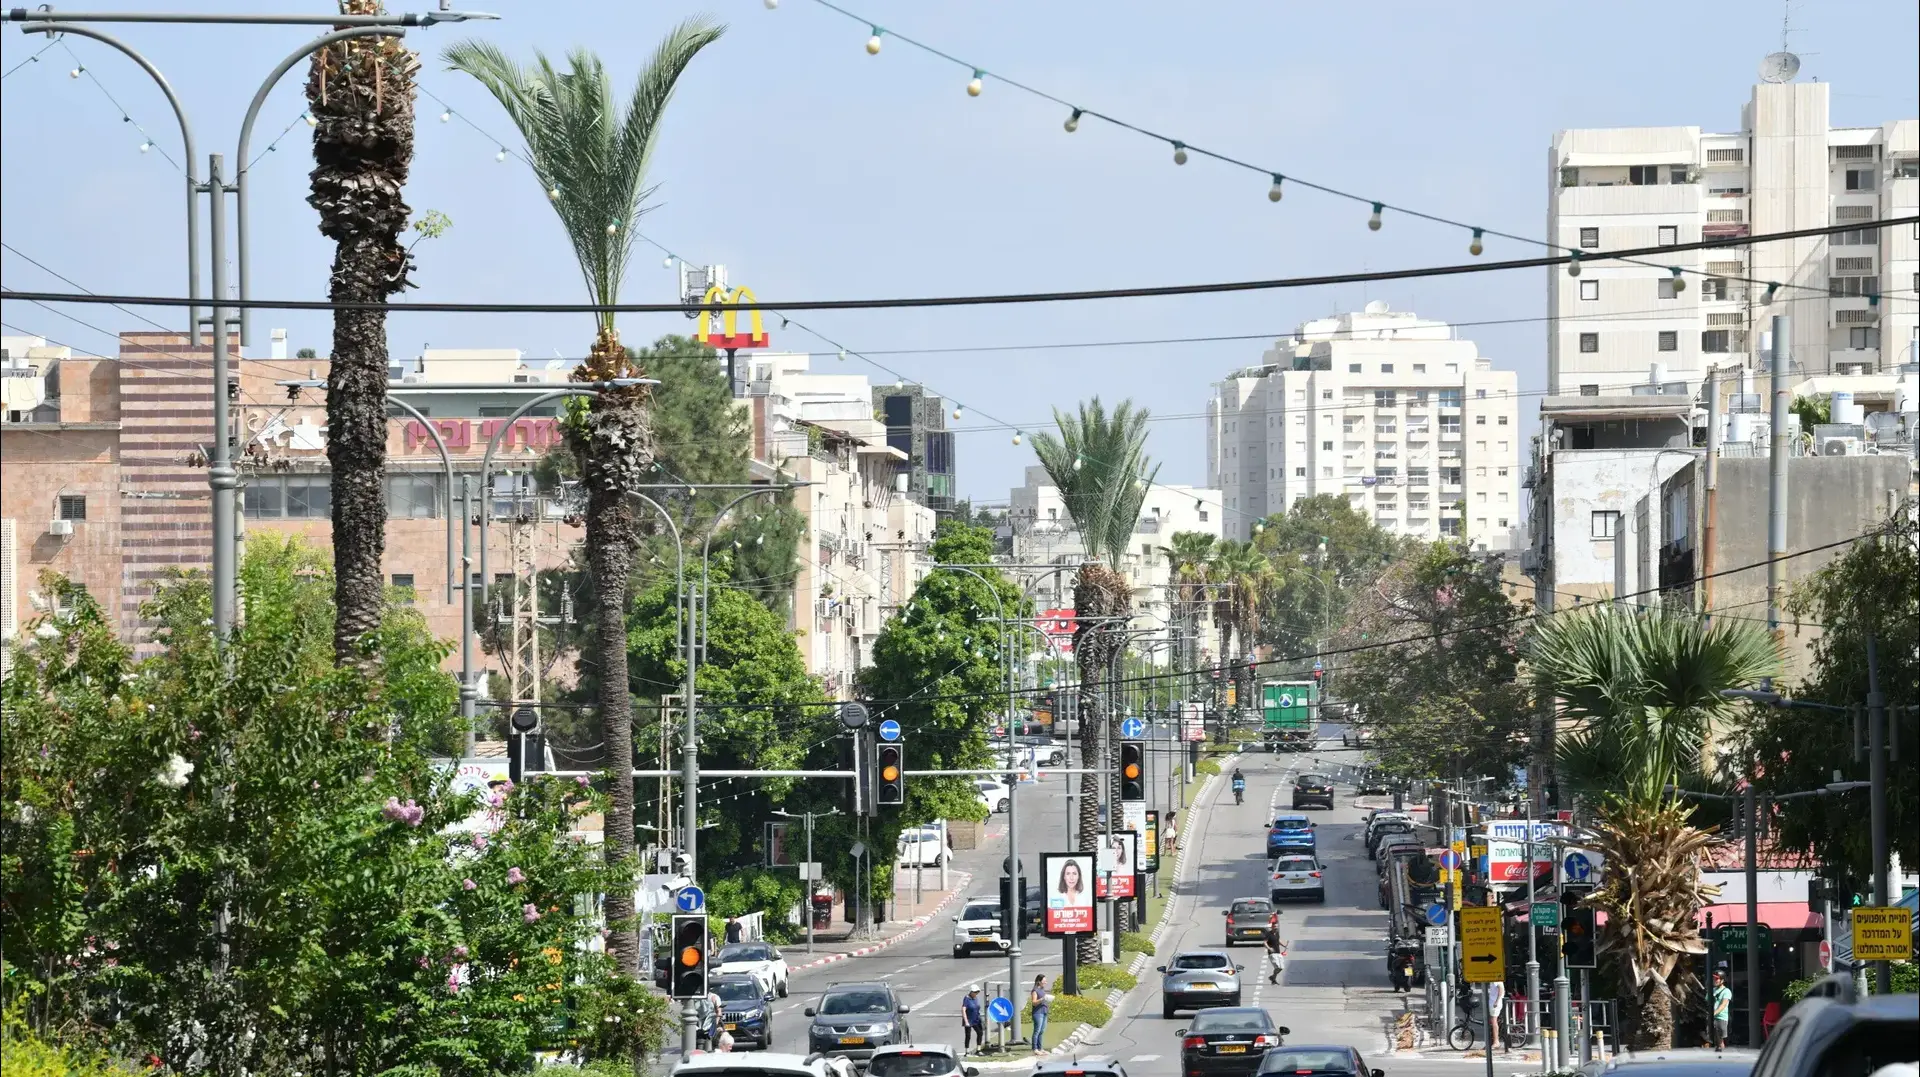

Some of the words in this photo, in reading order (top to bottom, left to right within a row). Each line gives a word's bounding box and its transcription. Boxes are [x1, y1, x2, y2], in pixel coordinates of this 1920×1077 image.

[1856, 913, 1887, 924] אופנועים
[1888, 913, 1907, 923] חניית
[1722, 927, 1749, 941] יאליק
[1861, 929, 1891, 939] המדרכה
[1892, 928, 1903, 939] על
[1857, 943, 1885, 954] בהחלט!
[1886, 944, 1909, 954] אסורה
